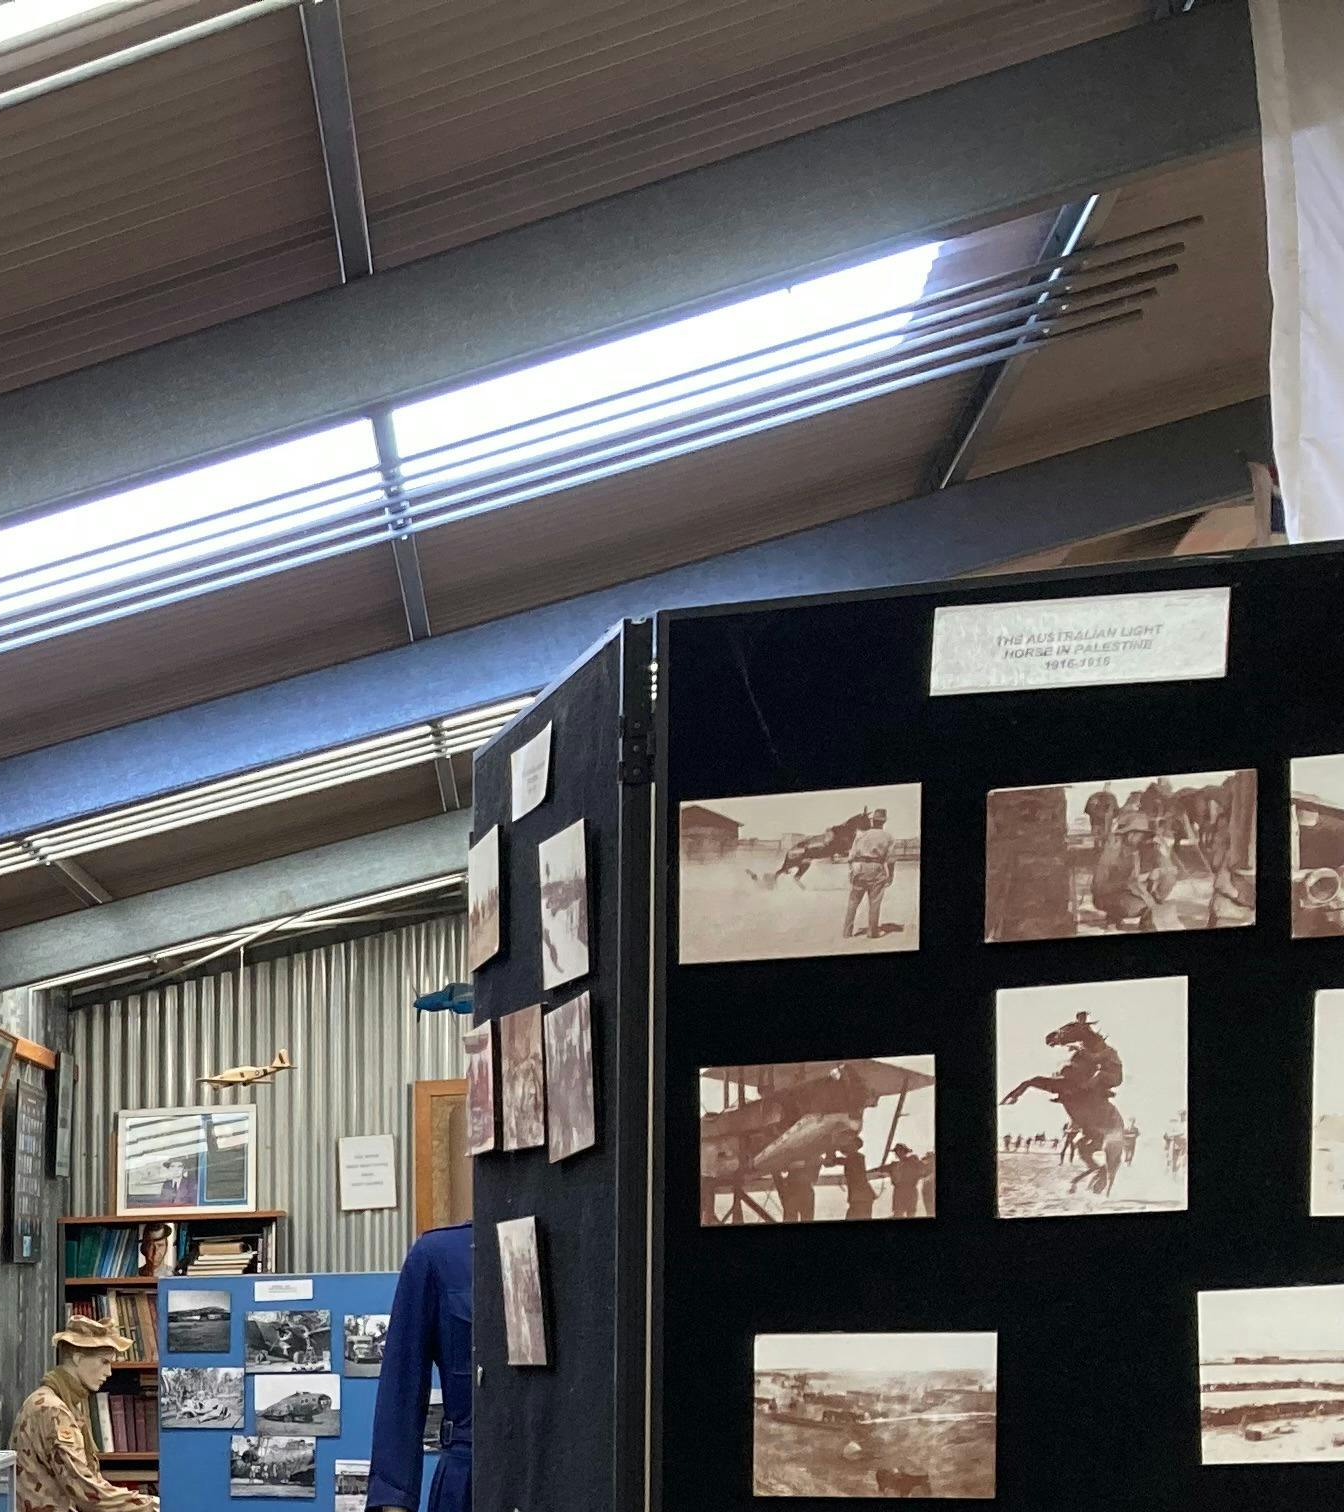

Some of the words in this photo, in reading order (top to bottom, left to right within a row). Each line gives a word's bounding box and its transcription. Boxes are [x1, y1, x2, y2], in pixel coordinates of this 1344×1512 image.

[997, 634, 1023, 647] THE
[1026, 628, 1117, 645] AUSTRALIAN
[1120, 623, 1164, 638] LIGHT
[1003, 647, 1053, 659] HORSE
[1056, 645, 1071, 656] IN
[1073, 639, 1153, 654] PALESTINE
